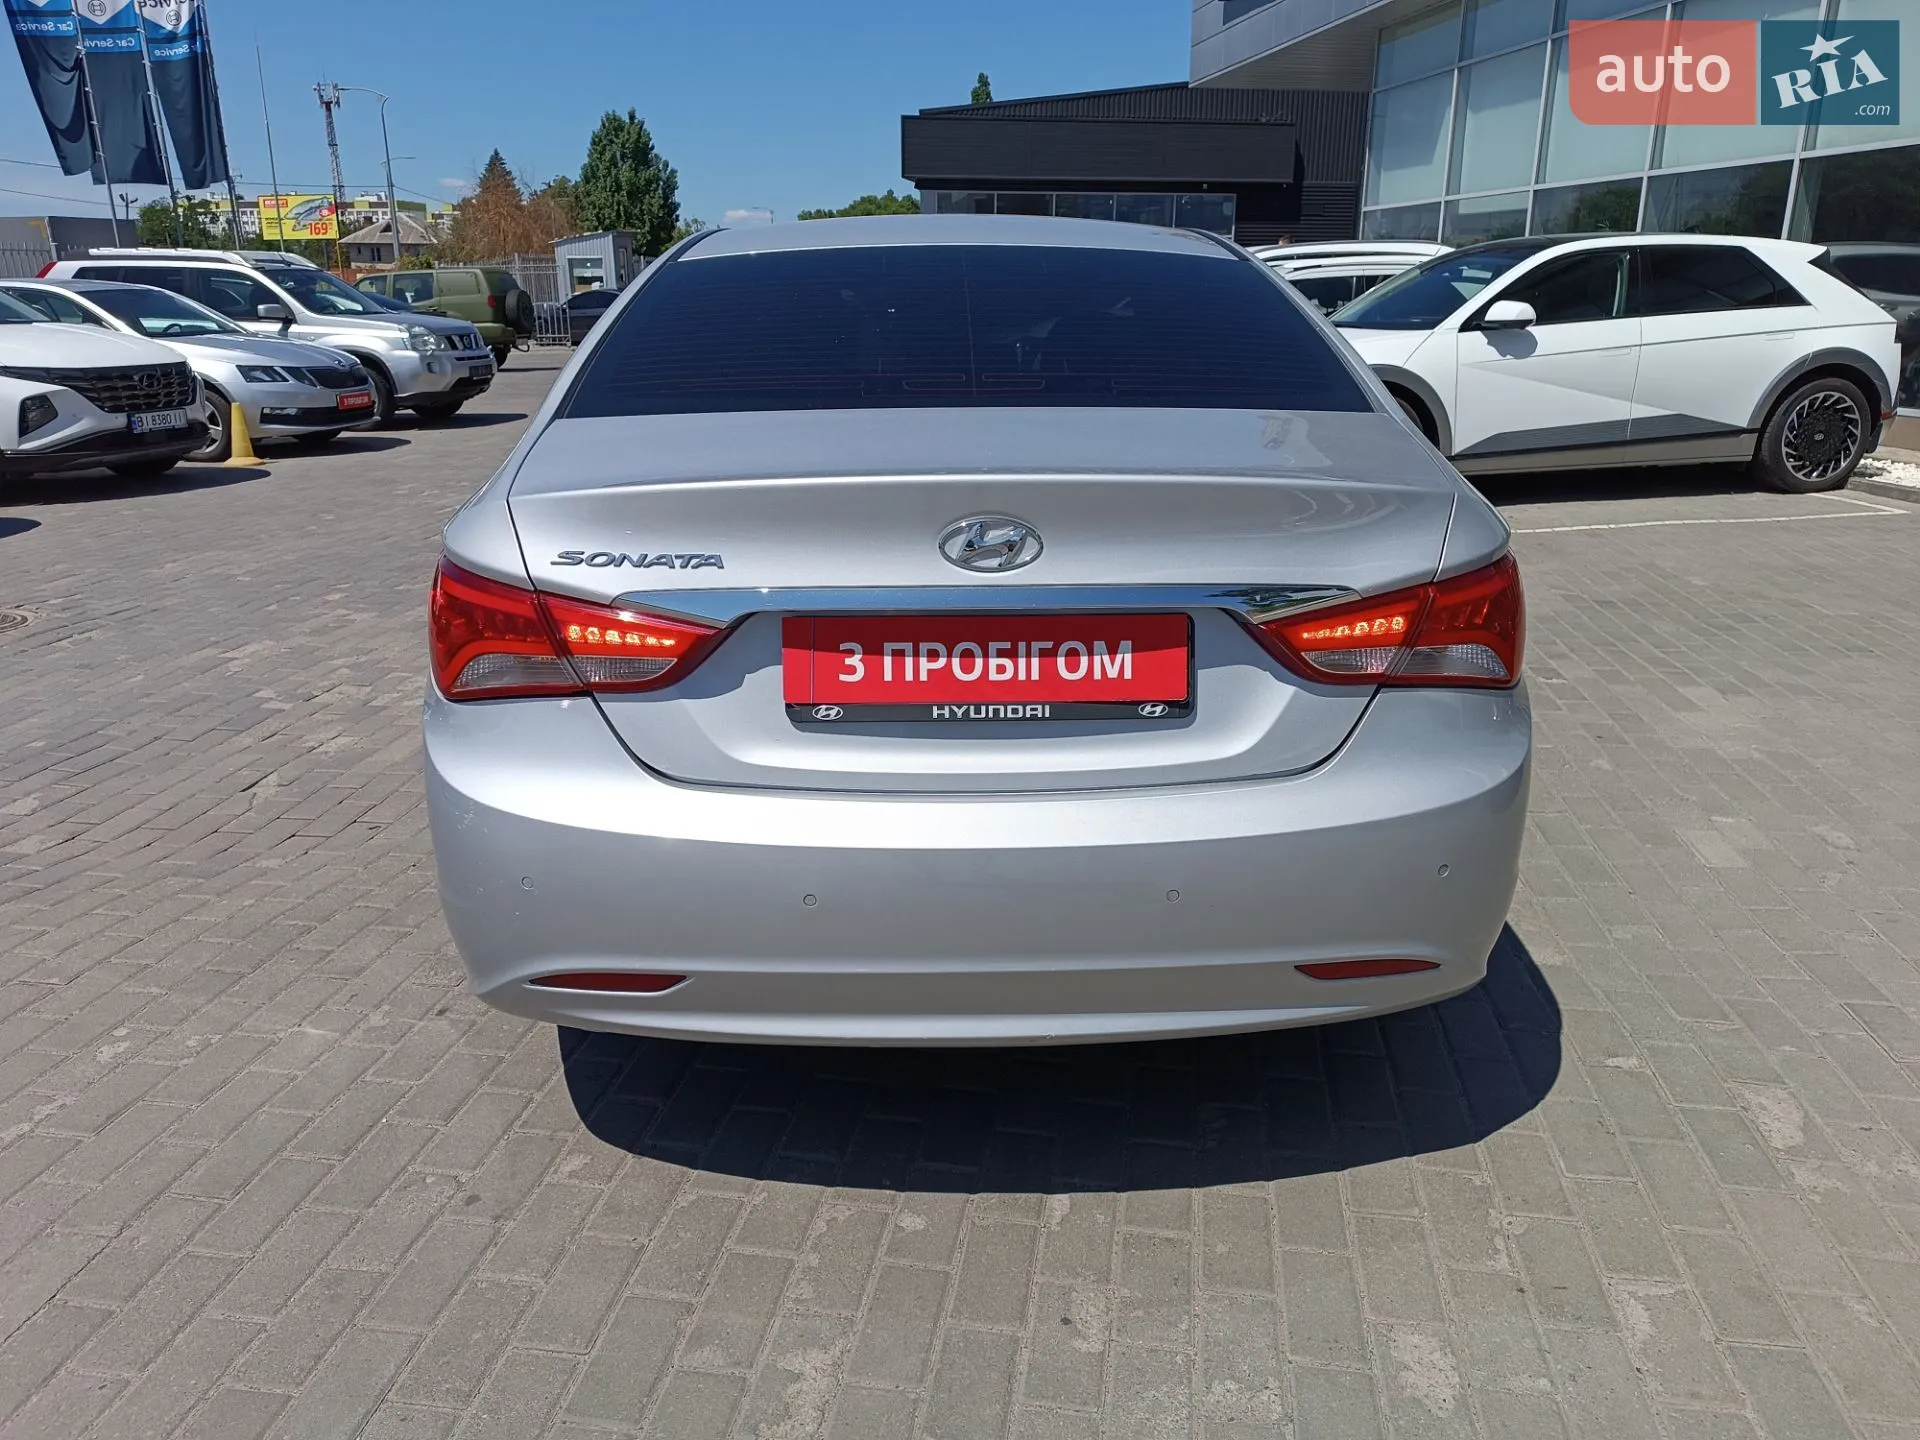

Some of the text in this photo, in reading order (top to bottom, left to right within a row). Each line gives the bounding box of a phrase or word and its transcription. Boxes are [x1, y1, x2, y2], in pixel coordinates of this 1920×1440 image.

[308, 221, 328, 236] 169
[550, 550, 725, 569] SONATA
[883, 640, 1133, 682] ПРОБІГОМ
[932, 704, 1050, 719] HYUNDAI
